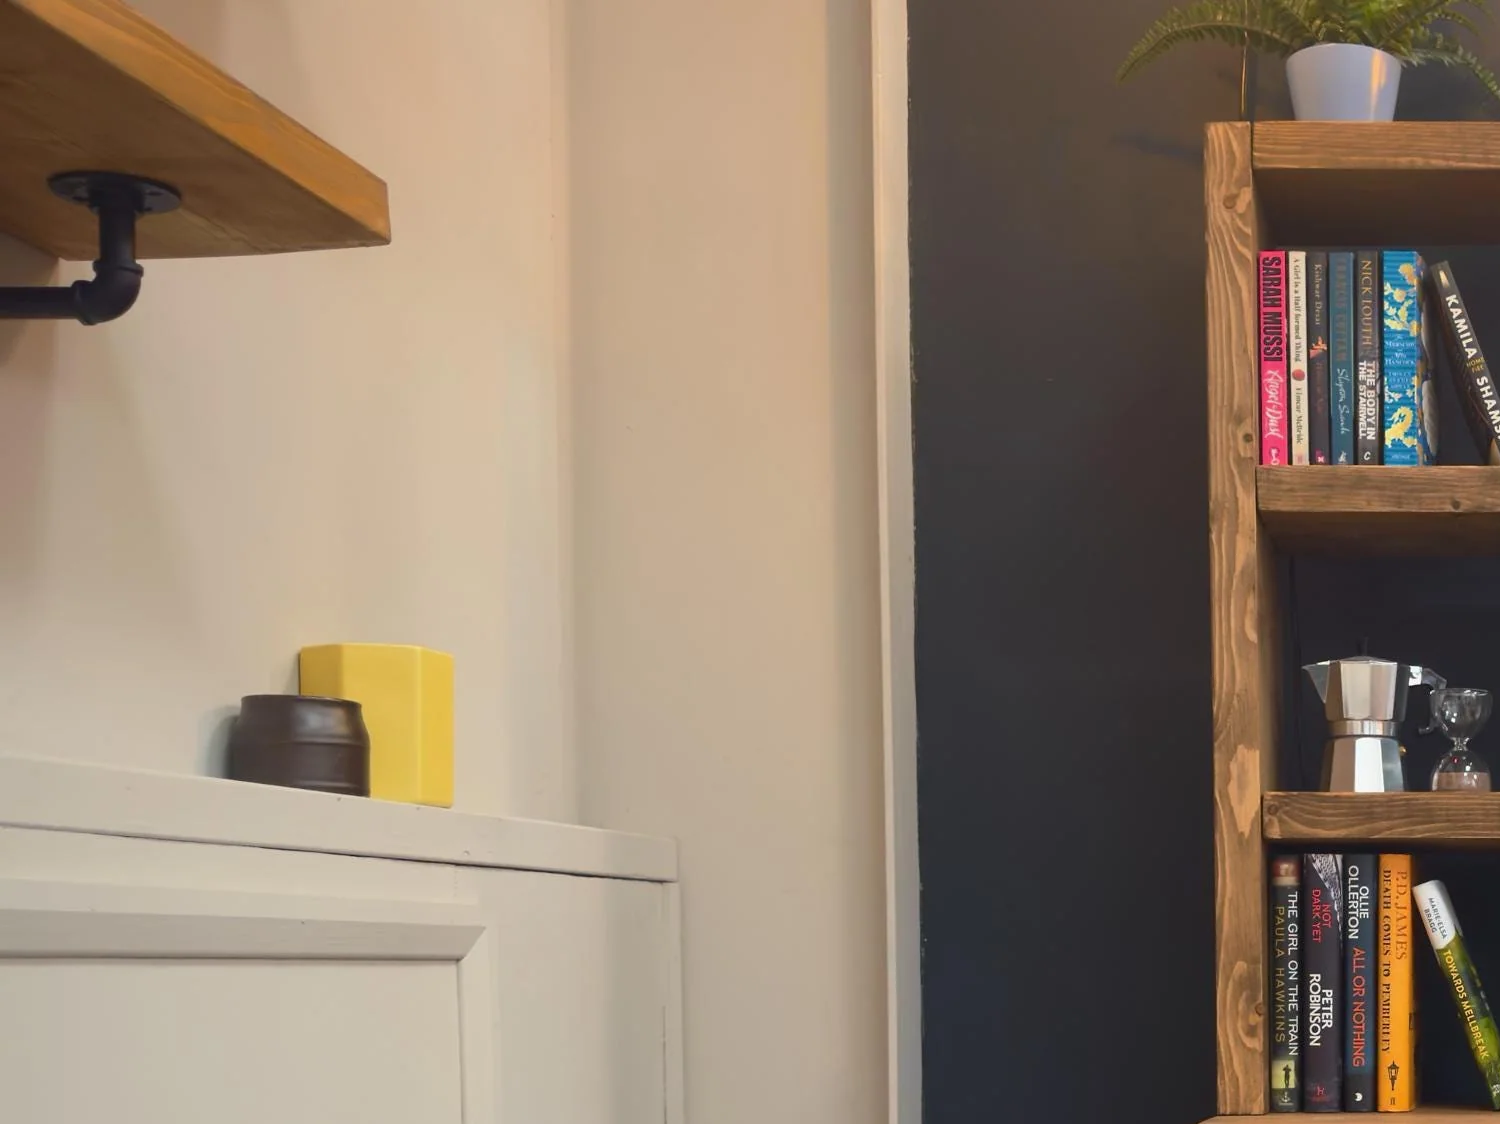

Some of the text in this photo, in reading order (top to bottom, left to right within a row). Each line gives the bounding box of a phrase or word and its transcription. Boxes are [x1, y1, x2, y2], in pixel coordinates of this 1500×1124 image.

[1262, 256, 1283, 362] SARAH MUSSI
[1293, 265, 1302, 280] Girl
[1314, 263, 1324, 325] Kishwar Desai
[1360, 259, 1373, 346] NICK LOUTH
[1294, 342, 1303, 362] Thing
[1446, 294, 1478, 359] KAMILA
[1358, 360, 1367, 439] THE STAIRWELL
[1366, 360, 1377, 440] THE BODY IN
[1312, 888, 1322, 943] DARK YET
[1321, 903, 1332, 928] NOT
[1348, 865, 1360, 940] OLLERTON
[1359, 885, 1370, 919] OLLIE
[1395, 901, 1408, 960] JAMES
[1423, 907, 1438, 934] BRAGG
[1275, 905, 1287, 1043] PAULA HAWKINS
[1287, 890, 1299, 1056] THE GIRL ON THE TRAIN
[1381, 869, 1392, 1052] DEATH COMES TO PEMBERLEY
[1309, 973, 1322, 1047] ROBINSON
[1321, 989, 1334, 1029] PETER
[1352, 946, 1367, 1068] ALL OR NOTHING
[1443, 948, 1491, 1060] TOWARDS MELLBREAK
